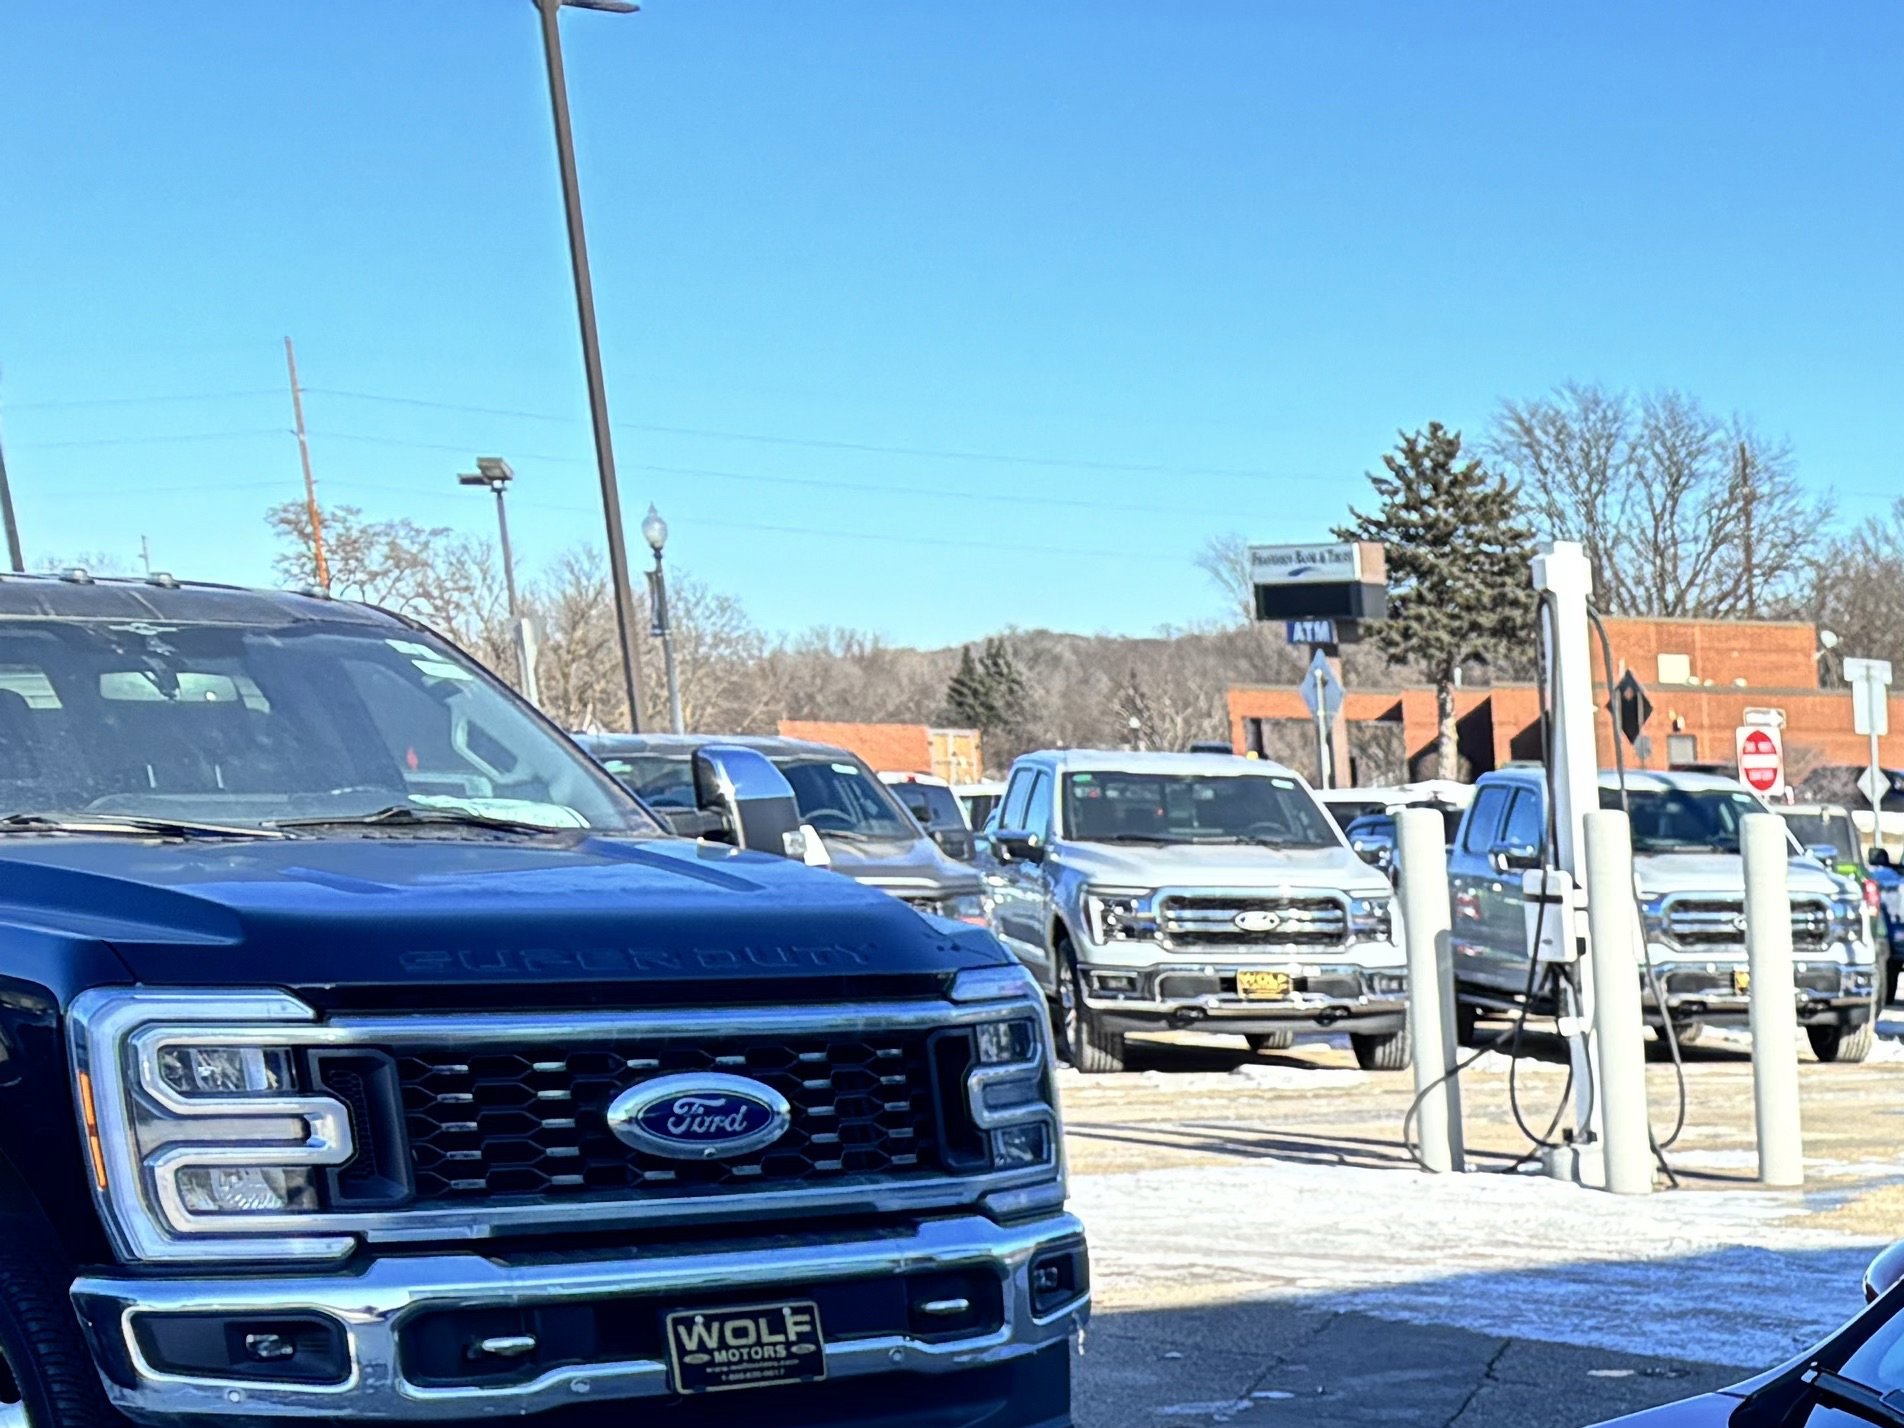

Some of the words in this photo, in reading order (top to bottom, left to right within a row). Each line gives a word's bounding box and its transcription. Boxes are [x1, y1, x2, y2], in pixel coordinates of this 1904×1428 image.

[1293, 620, 1331, 642] ATM
[667, 1096, 748, 1135] Ford
[677, 1314, 812, 1352] WOLF
[713, 1344, 787, 1364] MOTORS
